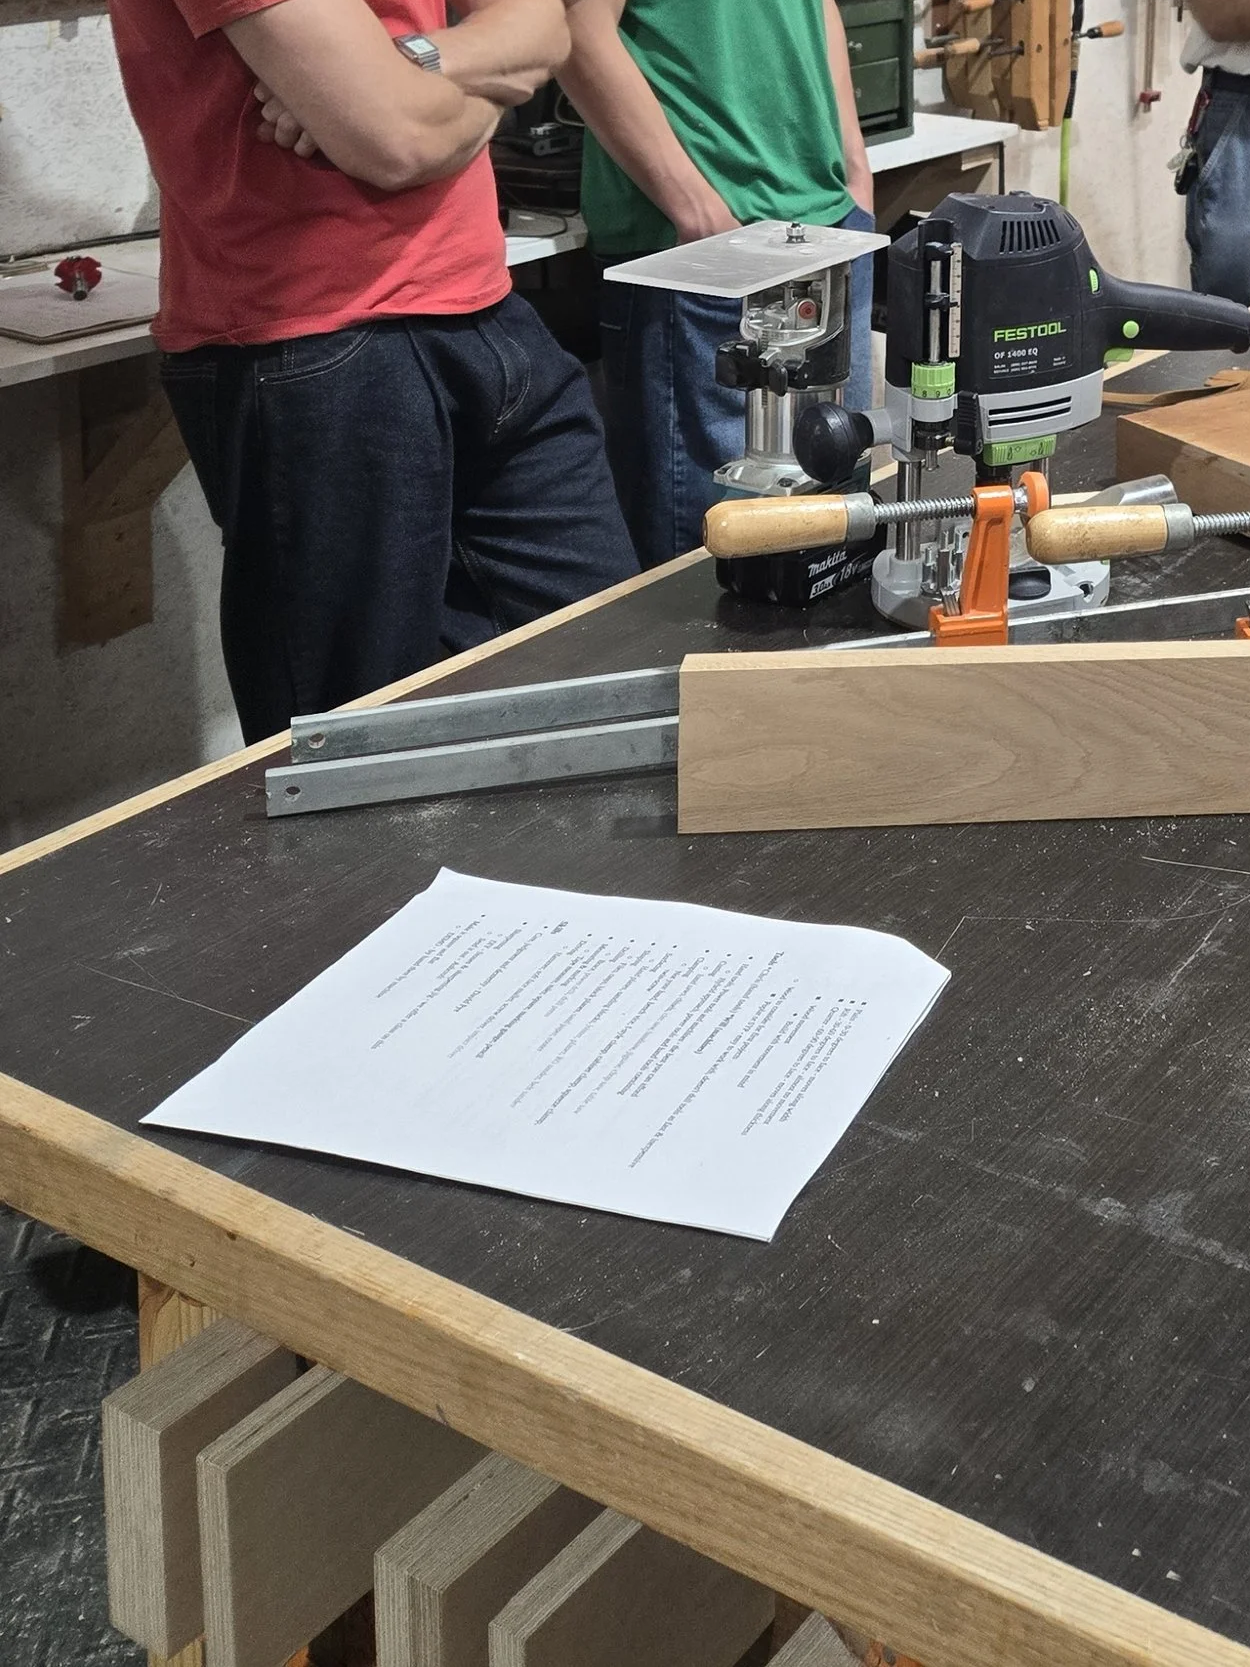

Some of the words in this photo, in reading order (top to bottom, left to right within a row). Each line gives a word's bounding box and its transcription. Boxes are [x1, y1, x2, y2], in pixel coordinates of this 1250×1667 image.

[994, 321, 1067, 343] FESTOOL
[994, 351, 1006, 360] OF
[1007, 349, 1027, 359] 1400
[1027, 347, 1039, 357] EQ
[807, 550, 848, 578] makita
